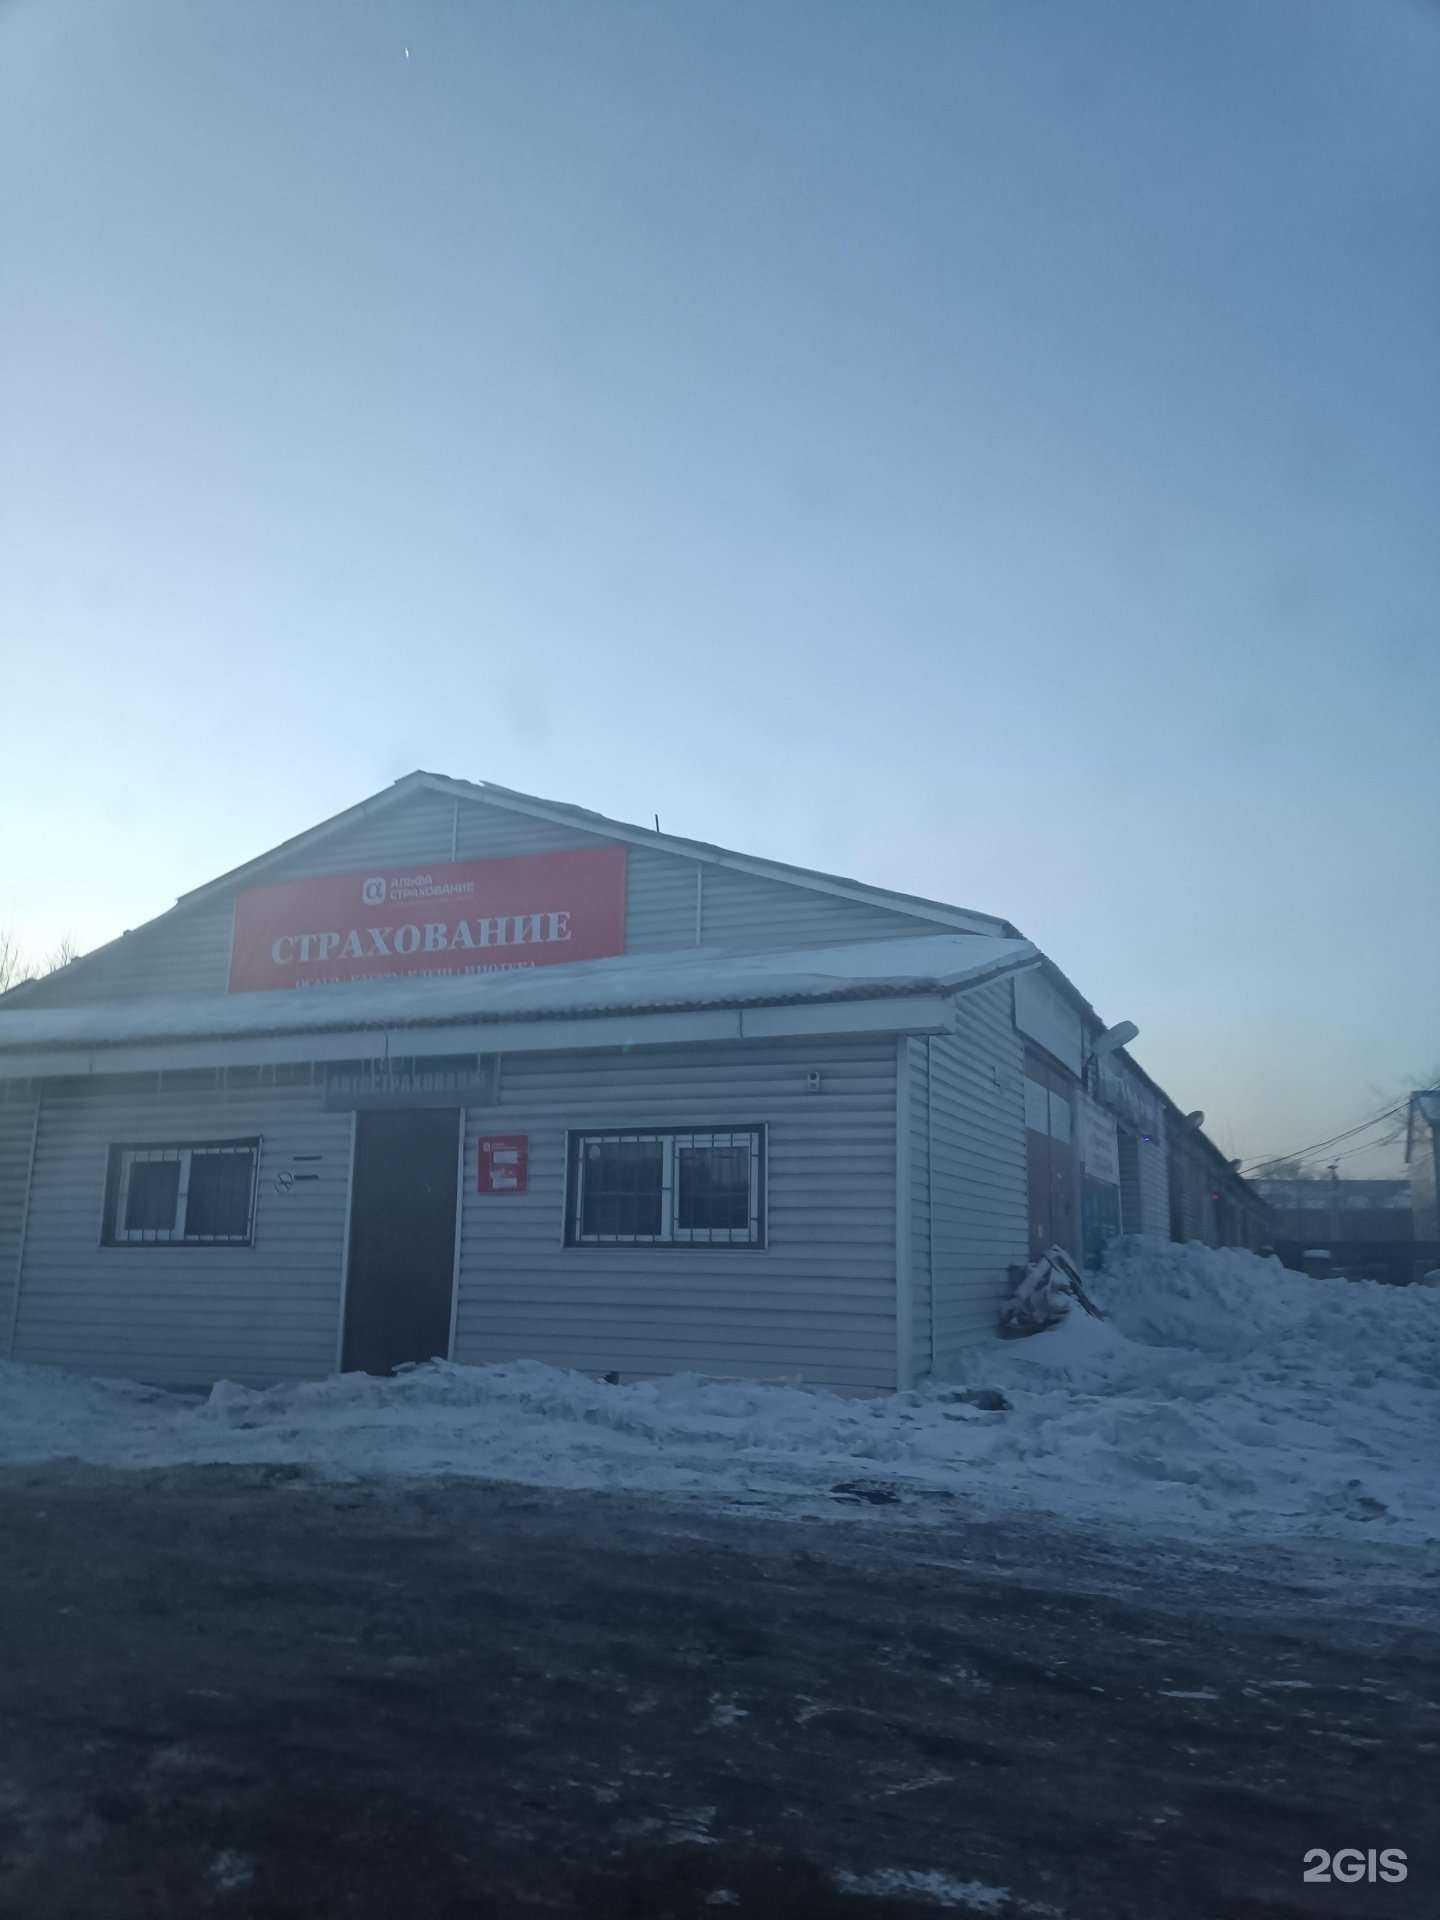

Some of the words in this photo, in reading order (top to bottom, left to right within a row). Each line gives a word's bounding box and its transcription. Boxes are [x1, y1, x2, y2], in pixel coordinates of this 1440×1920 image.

[390, 881, 475, 900] СТРАХОВАНИЕ
[391, 874, 433, 889] АЛЬФА
[272, 911, 572, 965] СТРАХОВАНИЕ
